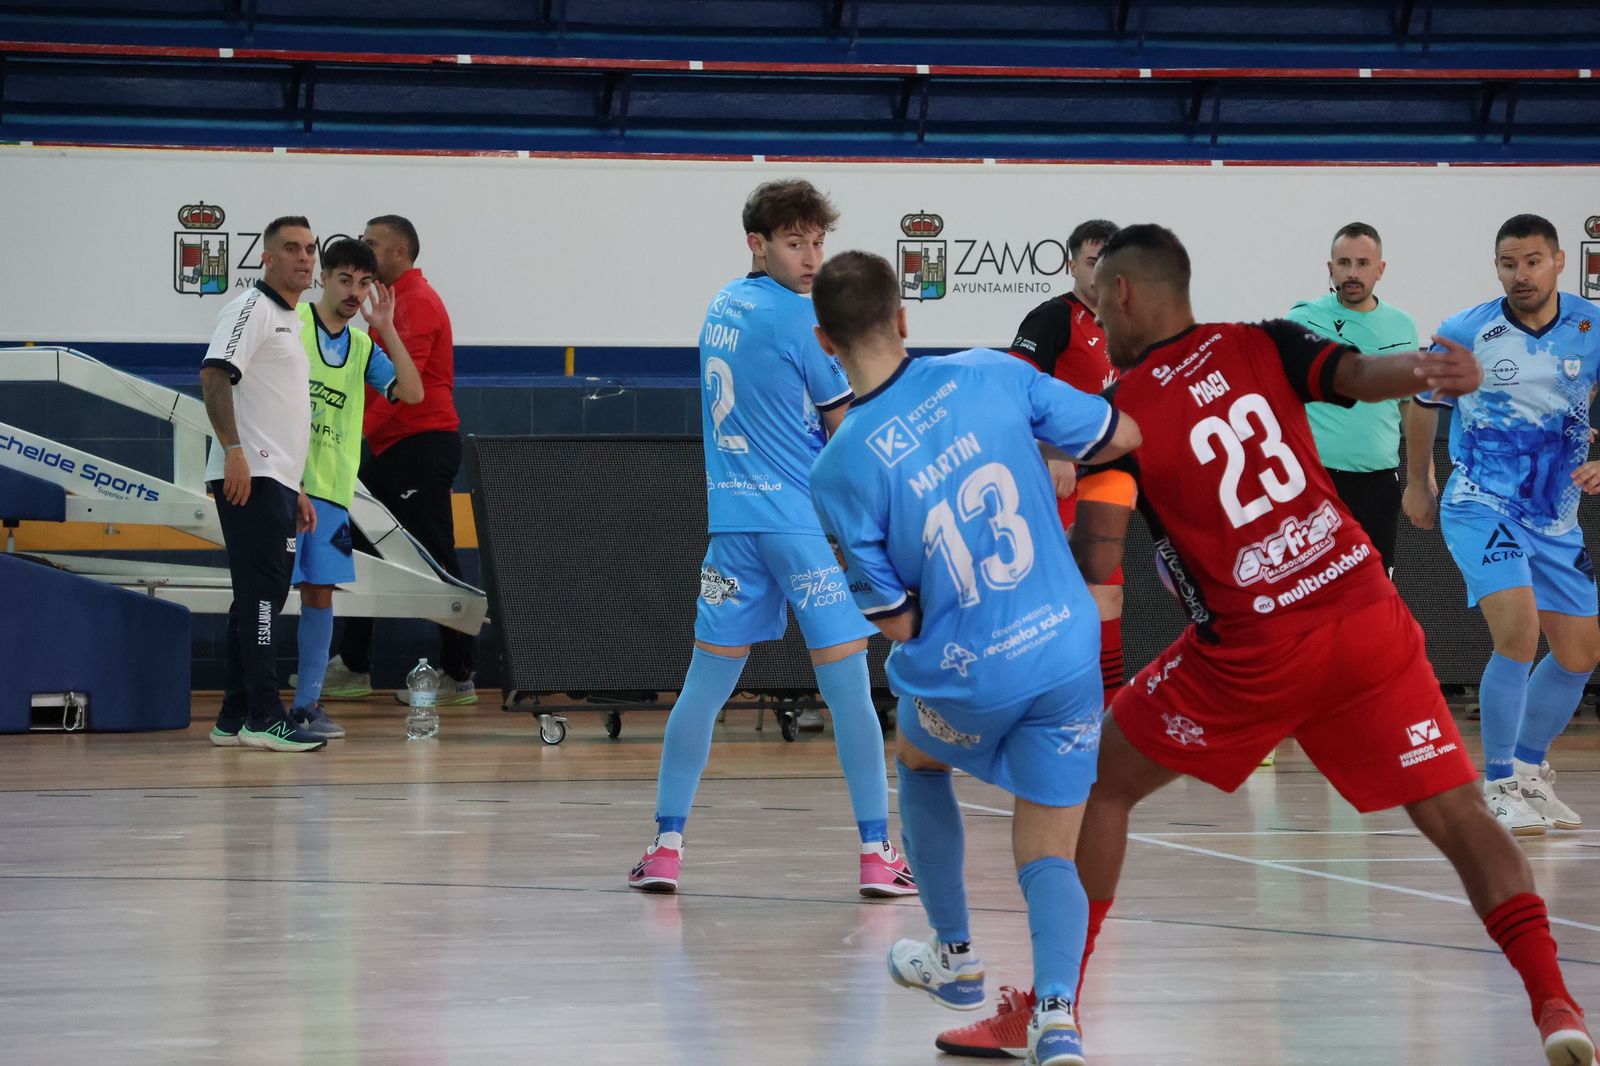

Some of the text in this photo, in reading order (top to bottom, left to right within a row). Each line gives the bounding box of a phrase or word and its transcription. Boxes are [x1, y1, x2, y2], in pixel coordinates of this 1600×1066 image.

[952, 282, 1051, 294] AYUNTAMIENTO
[704, 322, 740, 353] DOMI
[705, 357, 749, 454] 2
[907, 380, 957, 423] KITCHEN
[1188, 370, 1231, 408] MAGI
[916, 406, 948, 435] PLUS
[1190, 393, 1306, 529] 23
[80, 463, 160, 502] Sports
[923, 462, 1034, 608] 13
[1267, 540, 1332, 578] MACRODISCOTECA
[1278, 543, 1370, 607] multicolchón
[814, 590, 846, 606] .com
[1040, 604, 1071, 632] salud
[1400, 744, 1435, 761] HIERROS
[1402, 743, 1458, 768] MANUEL VIDAL
